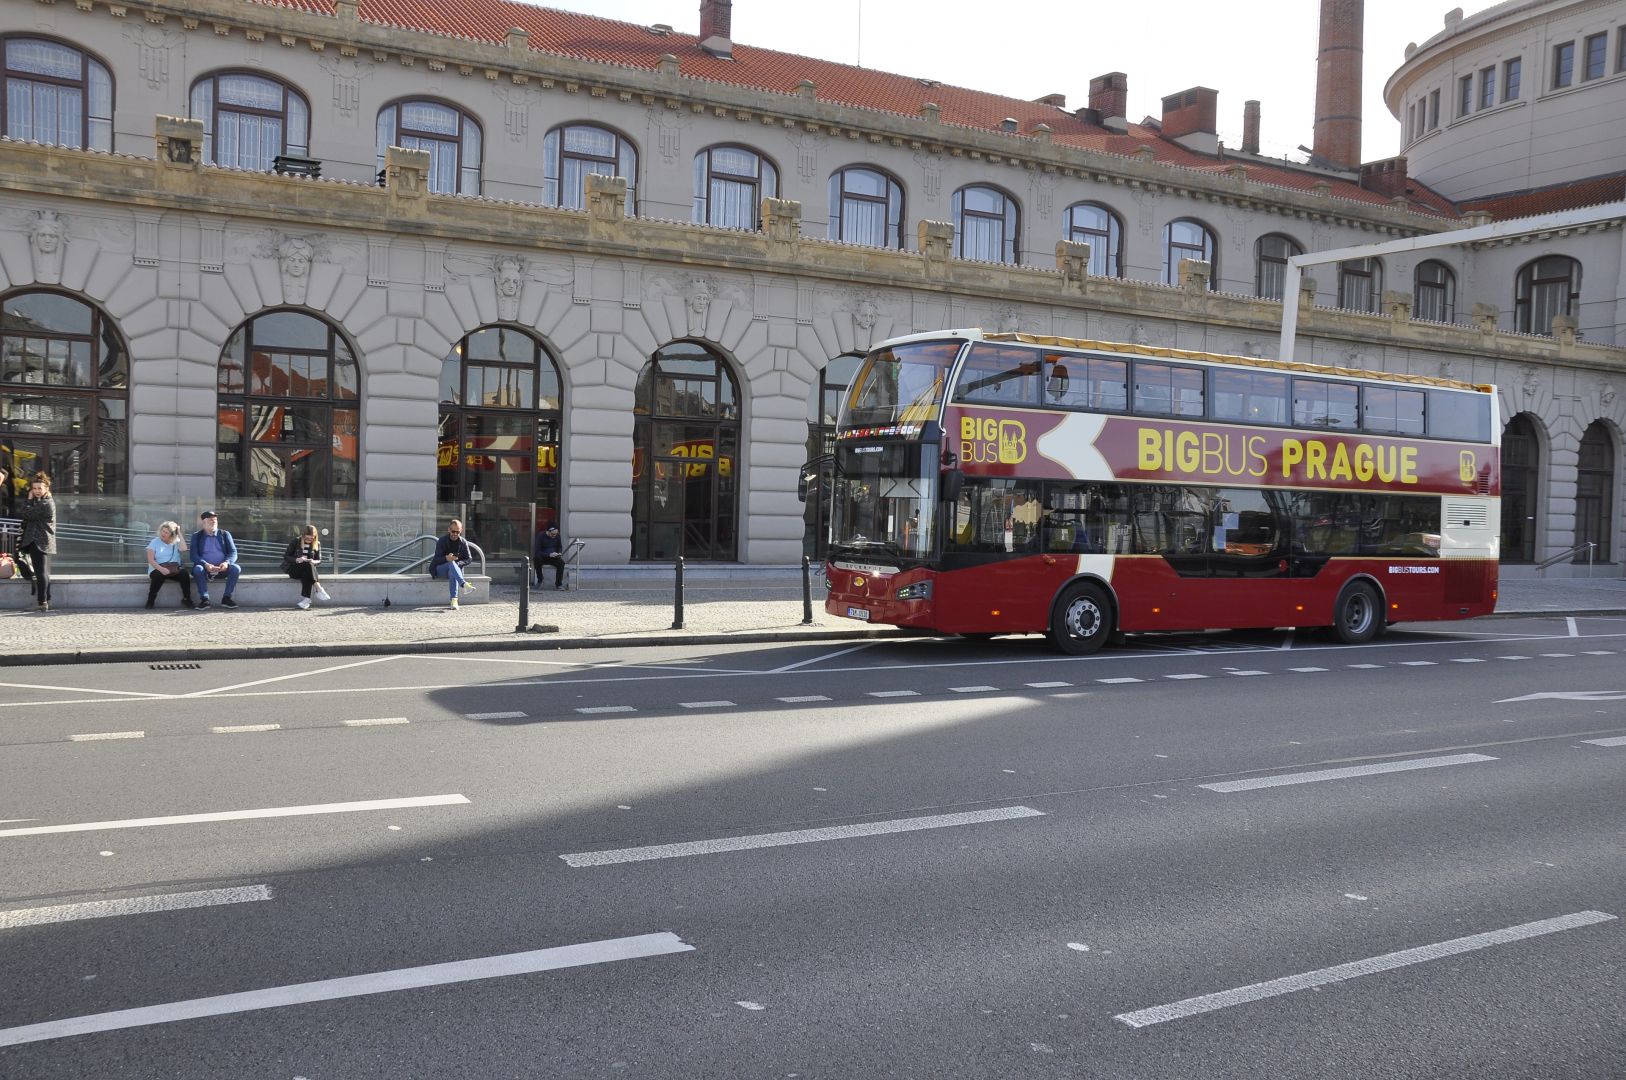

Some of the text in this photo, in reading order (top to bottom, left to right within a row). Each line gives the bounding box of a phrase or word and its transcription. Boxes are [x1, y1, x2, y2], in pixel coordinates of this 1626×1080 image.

[961, 417, 998, 441] BIG
[960, 441, 998, 463] BUS
[1282, 439, 1419, 484] PRAGUE
[1388, 566, 1440, 574] BIGBUSTOURS.COM
